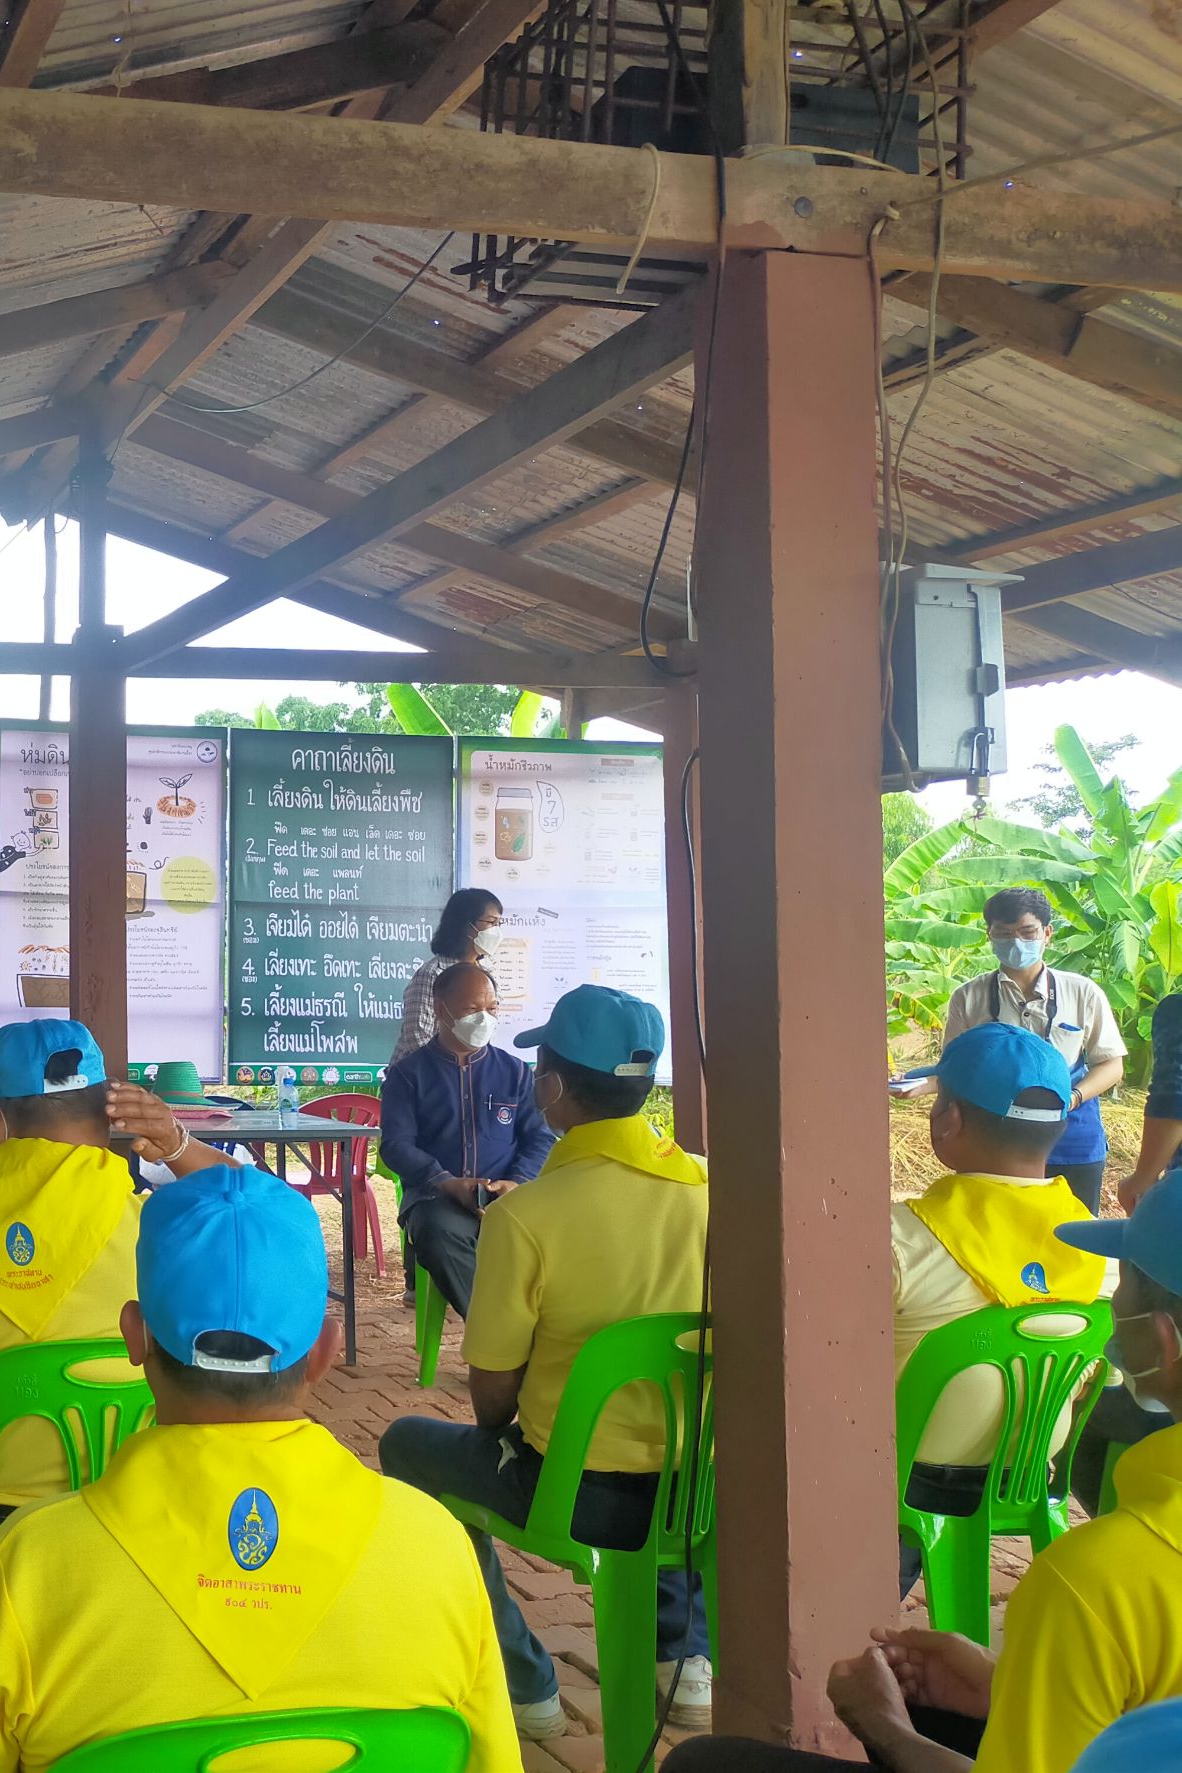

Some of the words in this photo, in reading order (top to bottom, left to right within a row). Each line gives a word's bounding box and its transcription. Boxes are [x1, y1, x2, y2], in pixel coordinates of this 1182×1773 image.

[292, 738, 396, 774] คาถาเลี้ยงดิน
[268, 778, 324, 809] เลี้ยงดิน
[323, 779, 423, 813] ให้ดินเลี้ยงพืช
[267, 838, 298, 857] Feed
[301, 840, 318, 859] the
[320, 842, 338, 859] soil
[341, 843, 360, 860] and
[365, 843, 380, 860] let
[383, 844, 402, 861] the
[405, 845, 425, 863] soil
[268, 879, 299, 899] feed
[303, 882, 323, 900] the
[328, 882, 360, 905] plant
[241, 997, 255, 1016] 5.
[264, 983, 348, 1018] เลี้ยงแม่ธรณี
[354, 983, 405, 1019] ให้แม่ธ
[264, 1020, 358, 1054] เลี้ยงแม่โพสพ
[197, 1573, 302, 1595] จิตอาสาพระราชทาน
